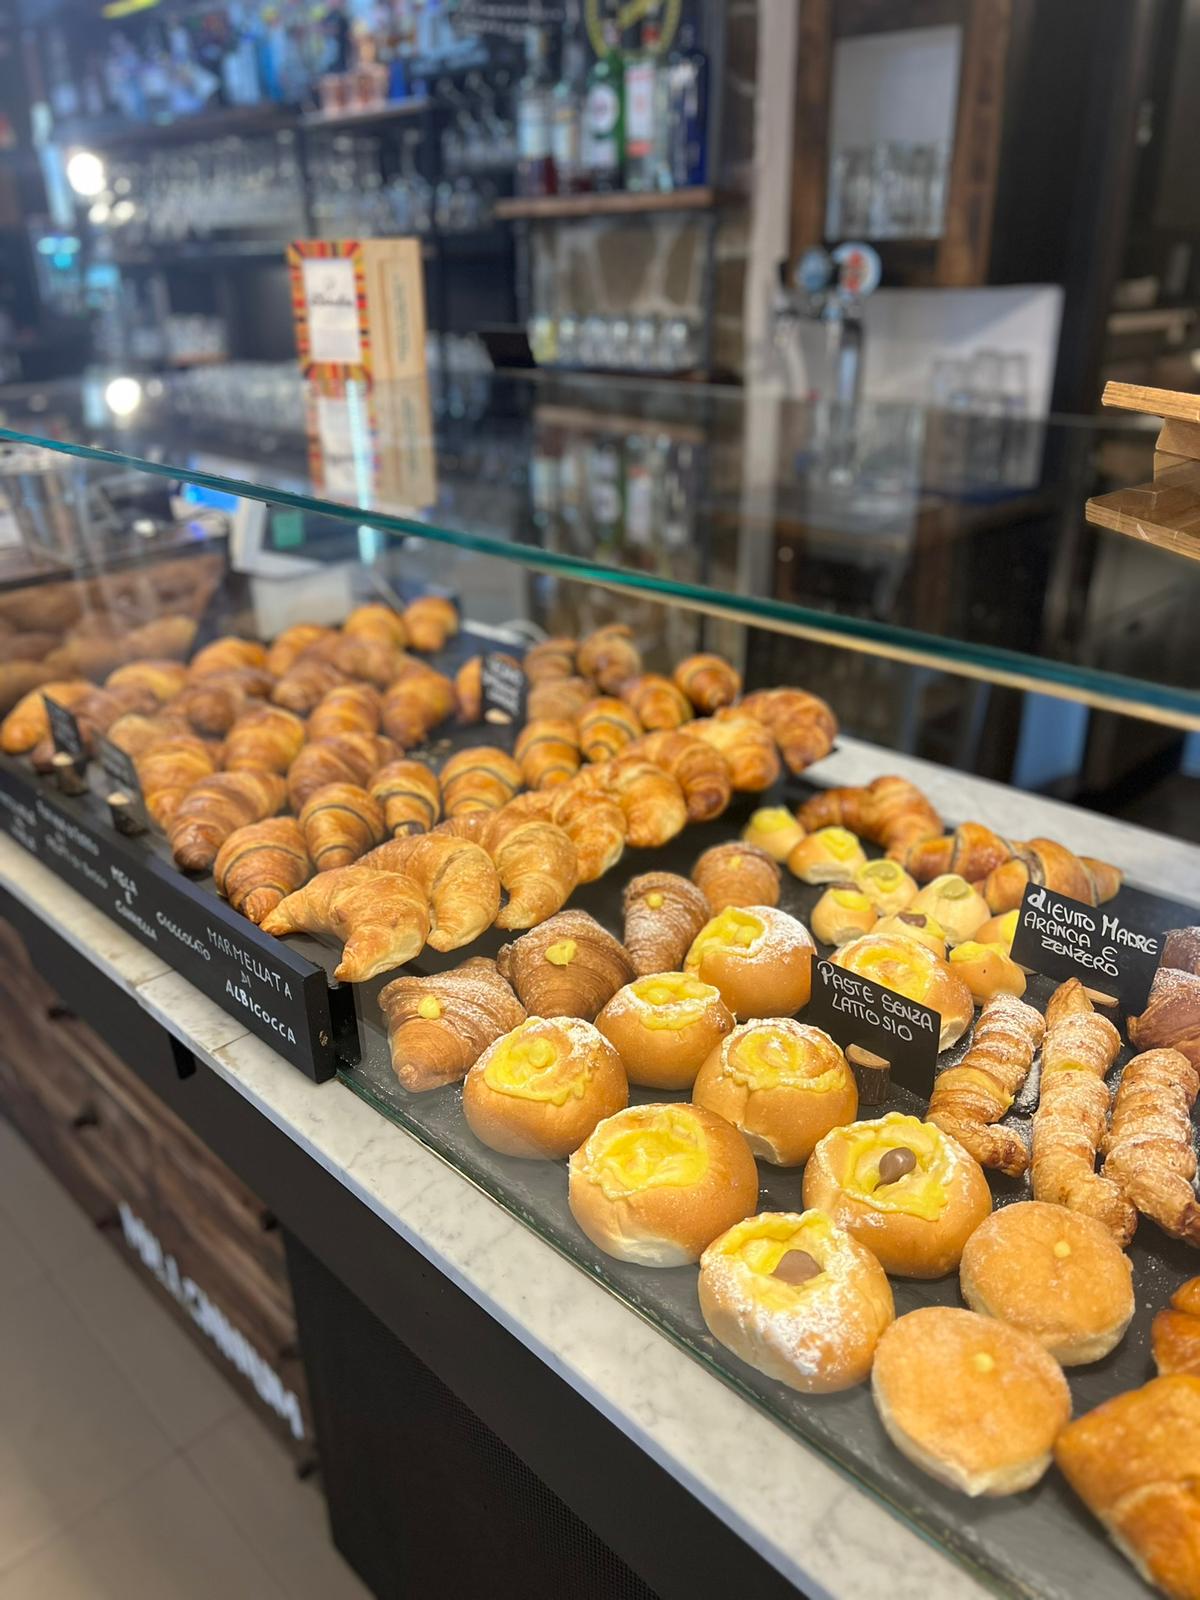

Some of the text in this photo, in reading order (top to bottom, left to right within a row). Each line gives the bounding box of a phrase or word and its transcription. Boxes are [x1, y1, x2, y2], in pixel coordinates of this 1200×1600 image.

[1041, 935, 1119, 977] ZENZERO
[1102, 914, 1158, 955] MADRE
[1102, 946, 1118, 962] E
[206, 927, 293, 1001] MARMELLATA
[225, 979, 297, 1045] ALBICOCCA
[817, 960, 934, 1033] PASTE SENZA
[832, 993, 913, 1041] LATTOSIO
